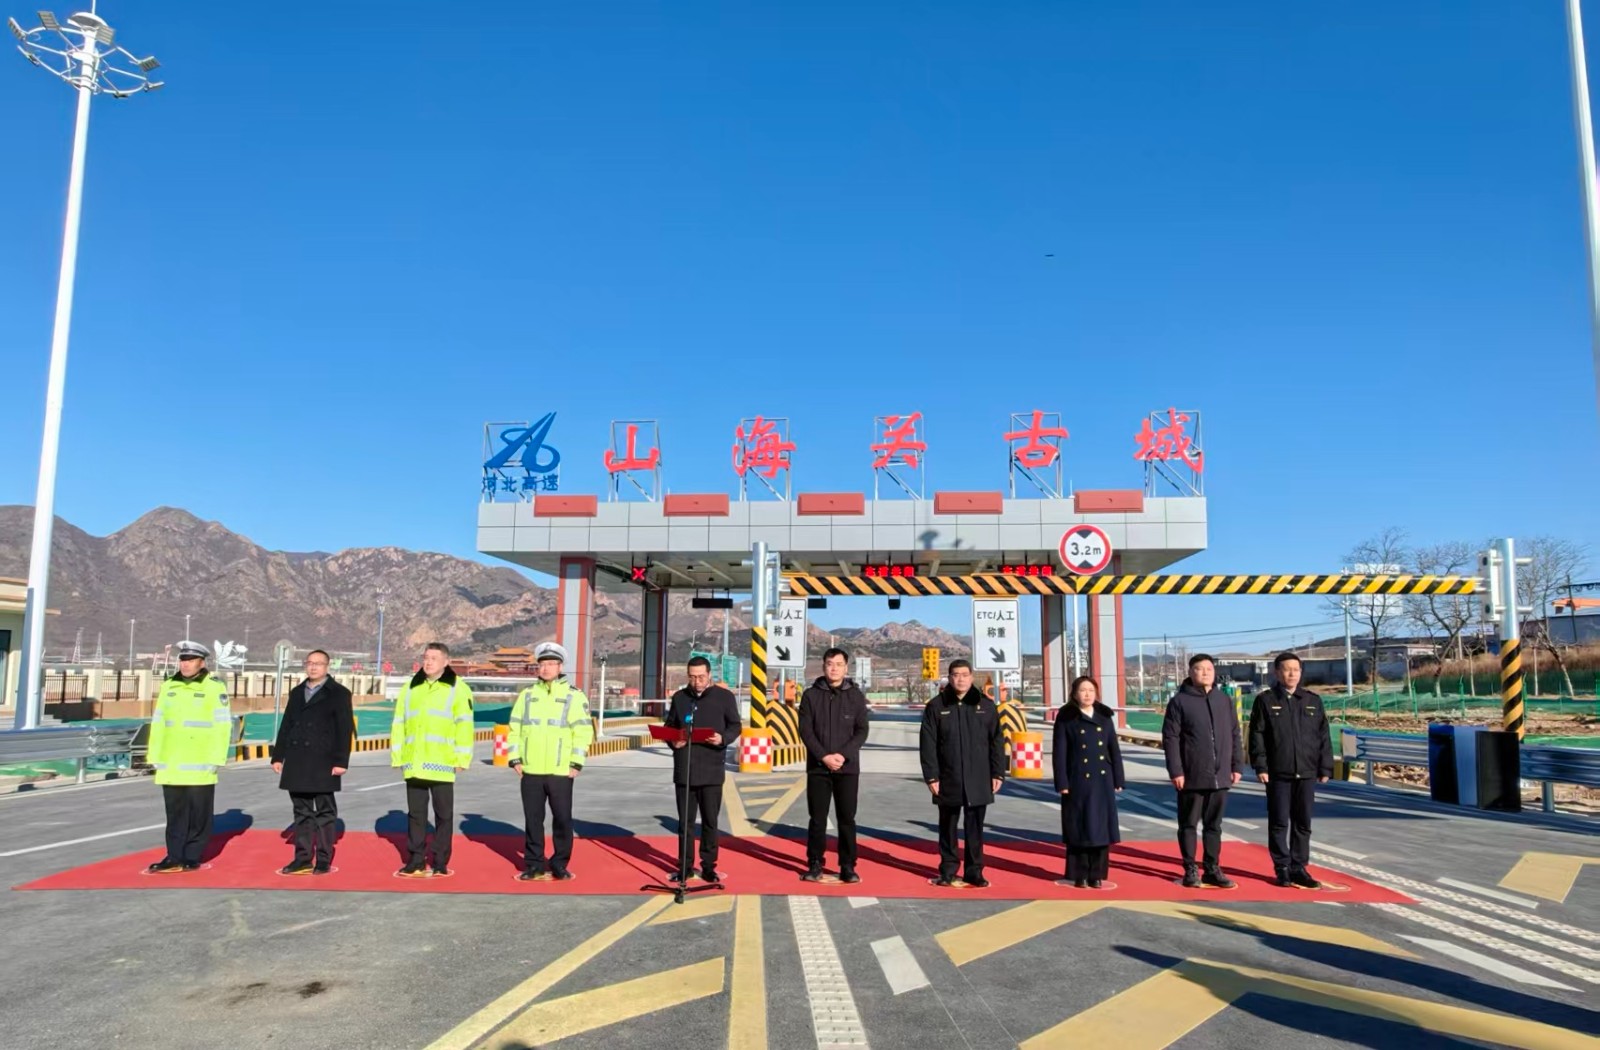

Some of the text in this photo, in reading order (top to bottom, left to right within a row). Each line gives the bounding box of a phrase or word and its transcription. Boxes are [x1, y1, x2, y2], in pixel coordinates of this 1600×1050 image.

[604, 408, 1204, 480] 山海关古城
[482, 472, 559, 497] 河北高速
[1071, 542, 1102, 556] 3.2m
[977, 610, 1014, 621] ETC/人工
[774, 625, 793, 637] 称重
[987, 627, 1006, 639] 称重
